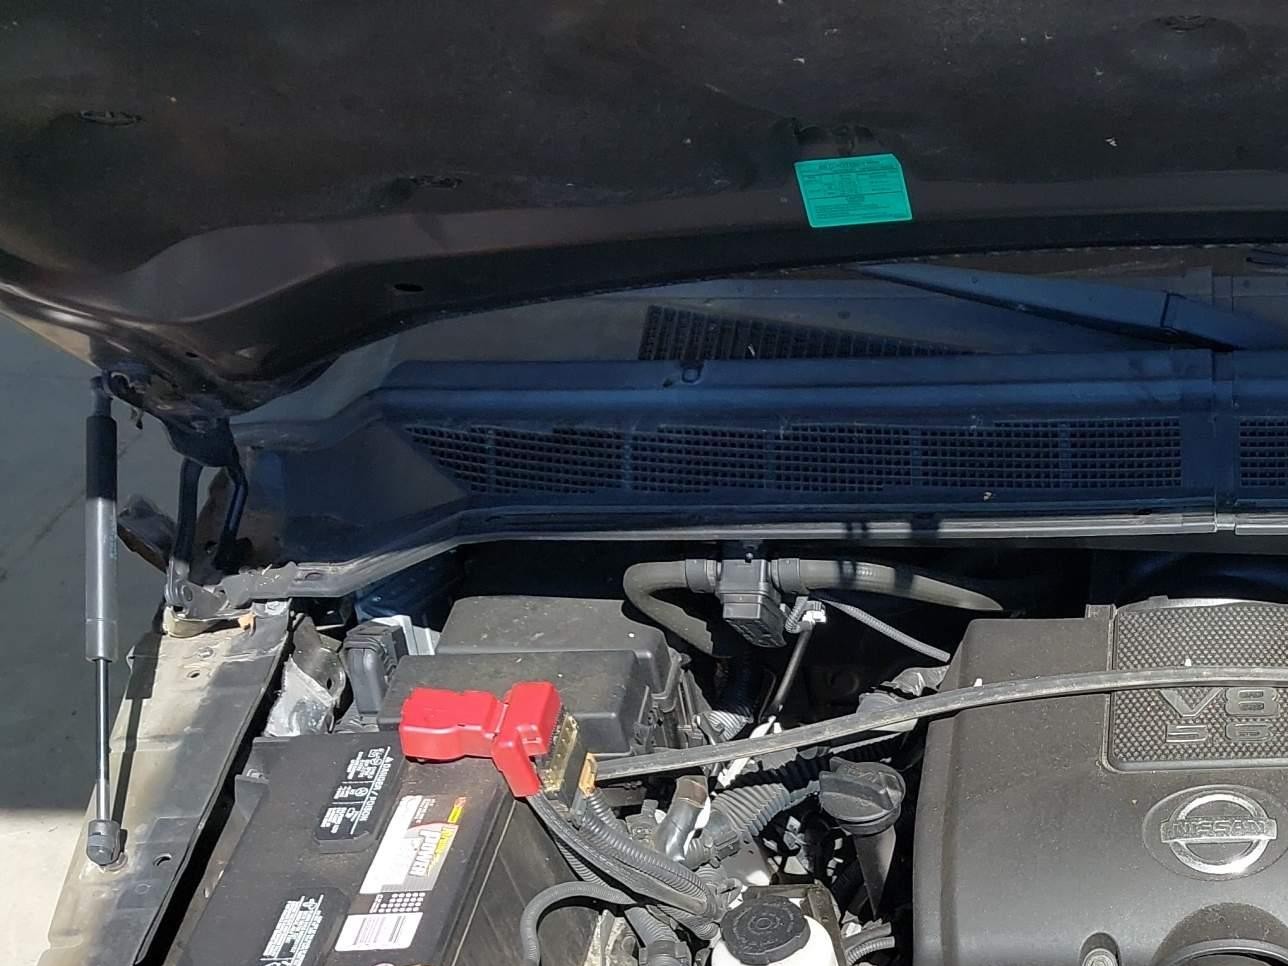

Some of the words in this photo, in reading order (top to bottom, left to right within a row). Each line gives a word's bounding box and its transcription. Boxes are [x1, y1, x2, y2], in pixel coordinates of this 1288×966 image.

[1158, 686, 1280, 718] V8
[372, 763, 392, 791] DANGER
[359, 796, 377, 822] POISON
[1172, 819, 1266, 837] NISSAN
